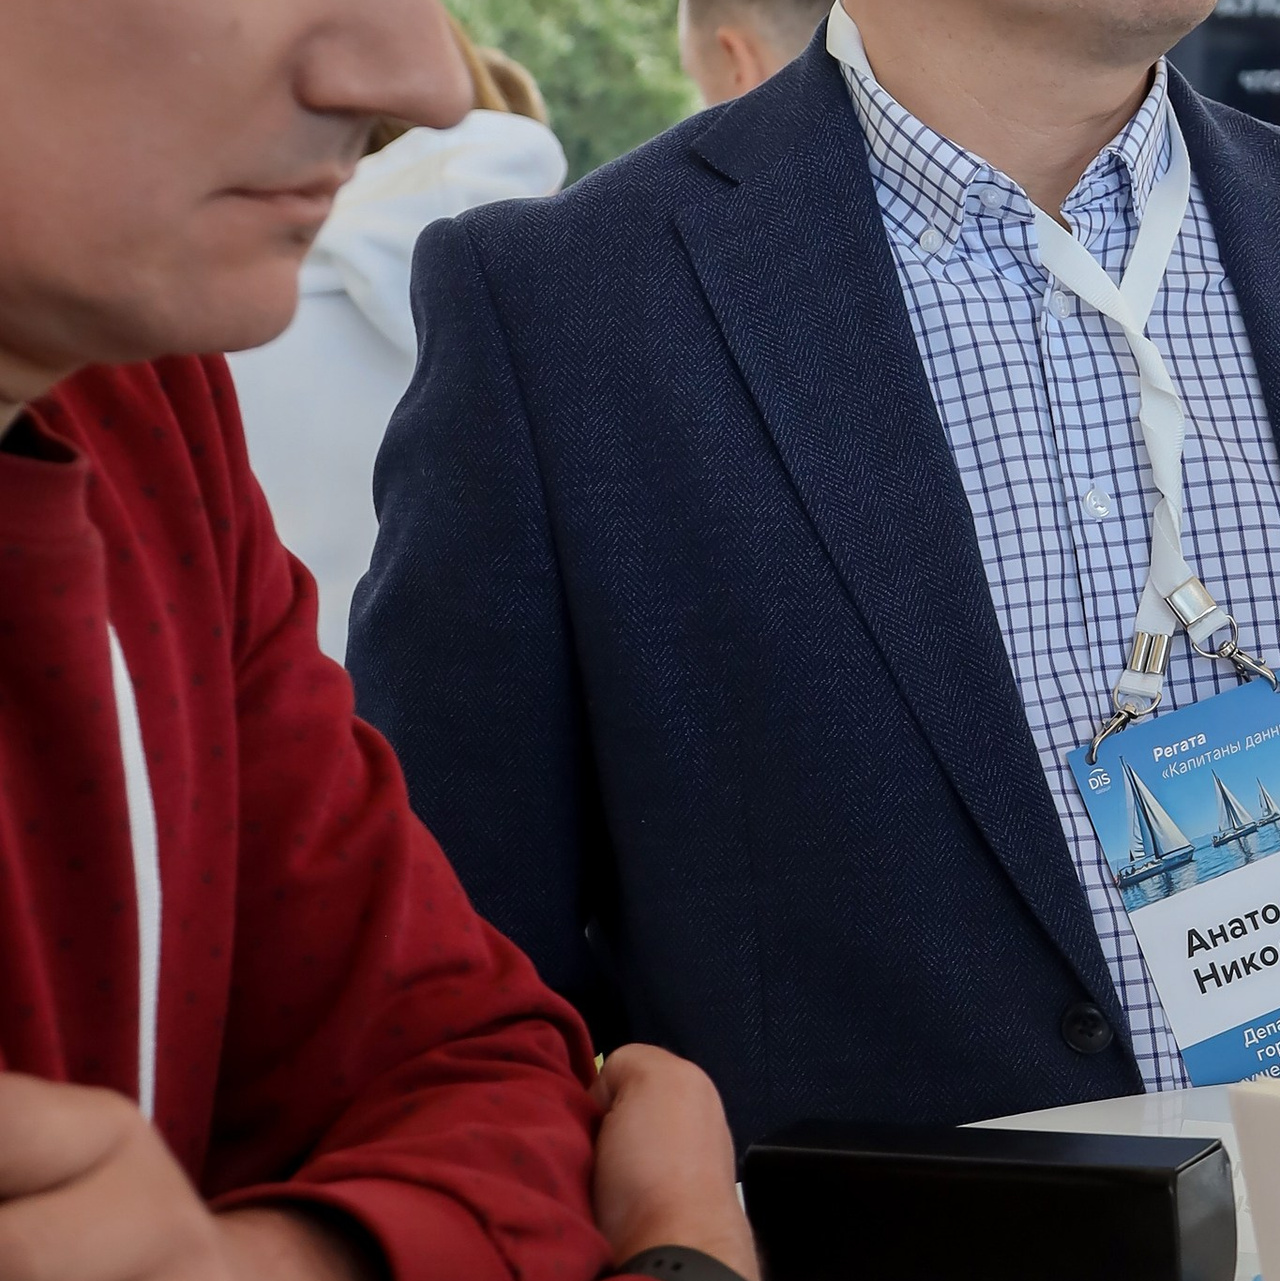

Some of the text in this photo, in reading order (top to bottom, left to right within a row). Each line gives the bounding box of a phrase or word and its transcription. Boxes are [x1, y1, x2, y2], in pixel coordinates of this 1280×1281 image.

[1153, 732, 1207, 762] Регата
[1162, 741, 1241, 779] «Капитаны
[1088, 773, 1111, 790] DIS
